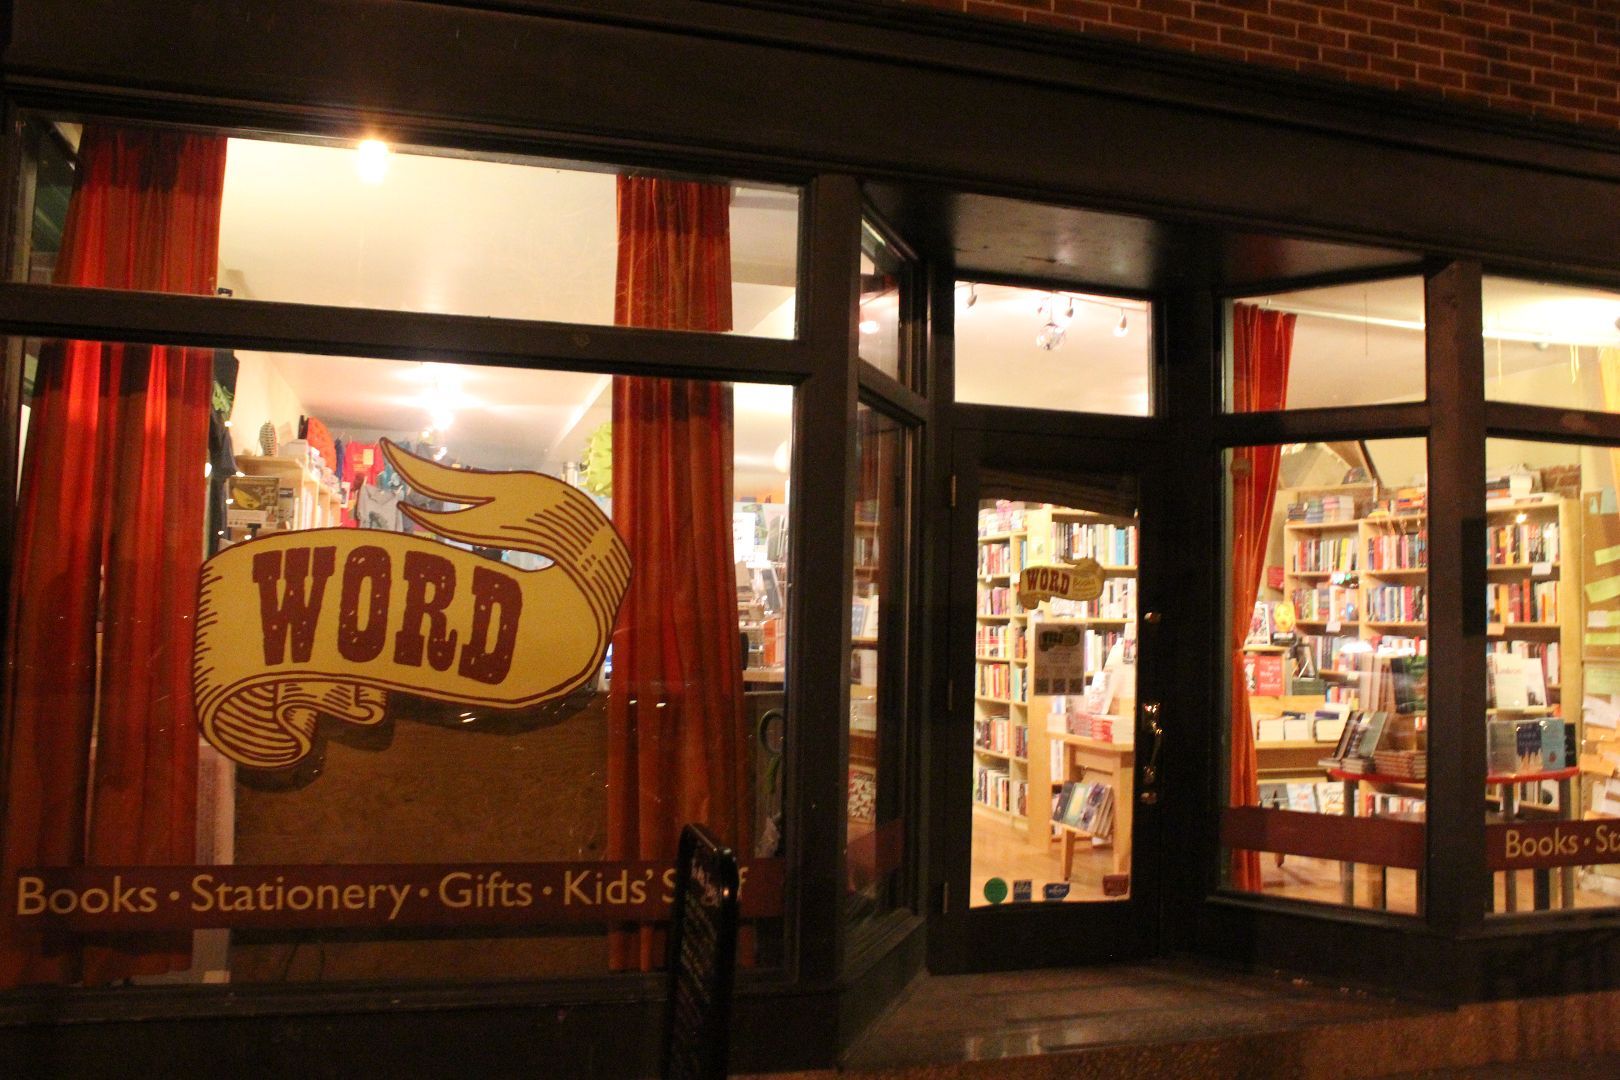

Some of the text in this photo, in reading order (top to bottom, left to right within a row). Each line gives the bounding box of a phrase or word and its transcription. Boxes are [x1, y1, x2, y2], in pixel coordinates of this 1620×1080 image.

[1026, 567, 1070, 595] WORD
[252, 545, 523, 685] WORD
[1505, 827, 1579, 858] Books
[16, 875, 157, 915] Books
[191, 873, 412, 920] Stationery
[438, 871, 533, 908] Gifts
